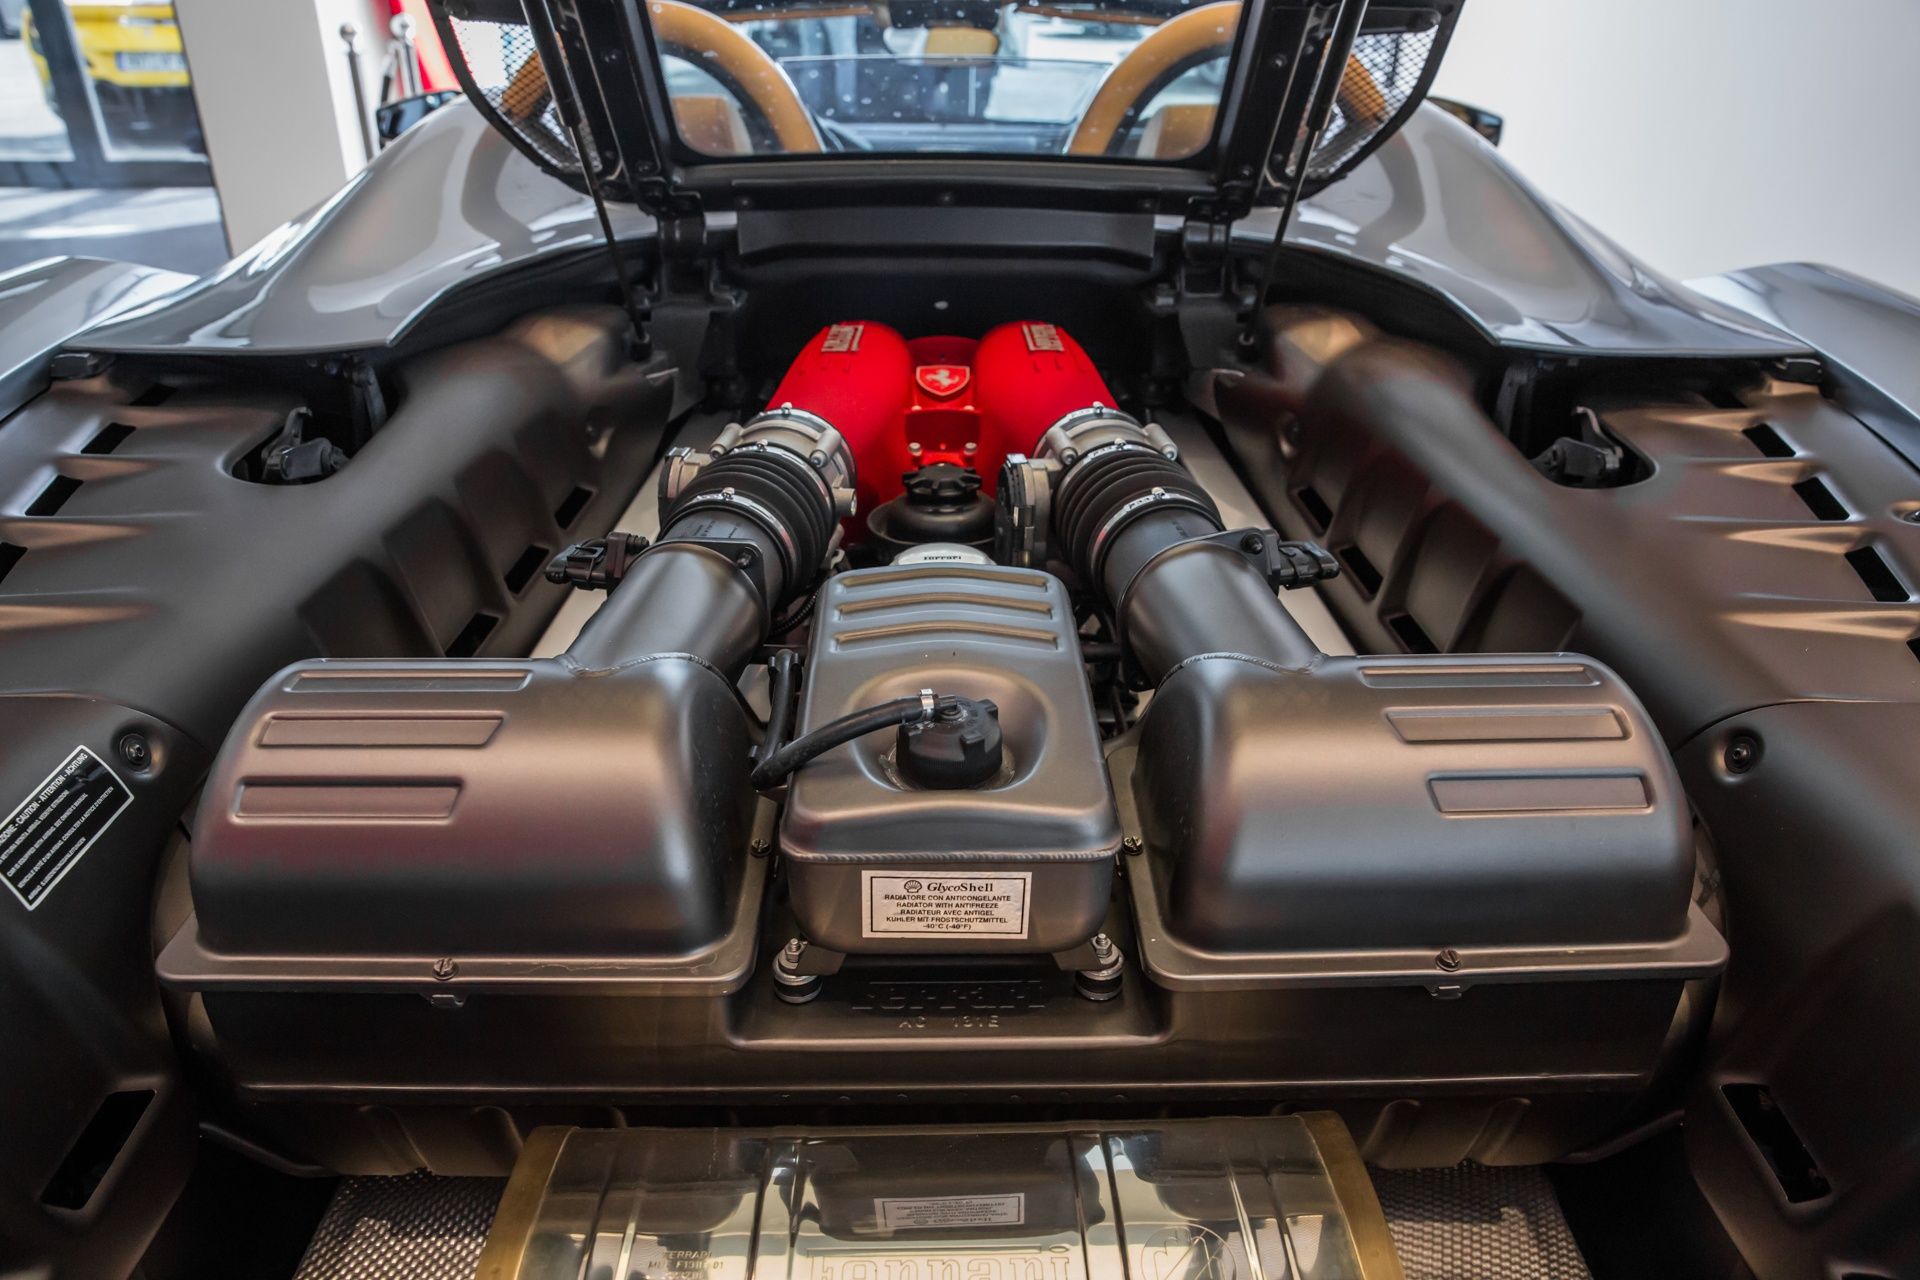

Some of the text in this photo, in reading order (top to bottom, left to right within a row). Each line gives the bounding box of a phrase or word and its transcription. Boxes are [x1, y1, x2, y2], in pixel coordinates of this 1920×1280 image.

[15, 800, 39, 825] CAUTION
[38, 773, 65, 801] ATTENTION
[64, 751, 88, 775] ACHTUNG
[926, 882, 993, 893] GlycoShell
